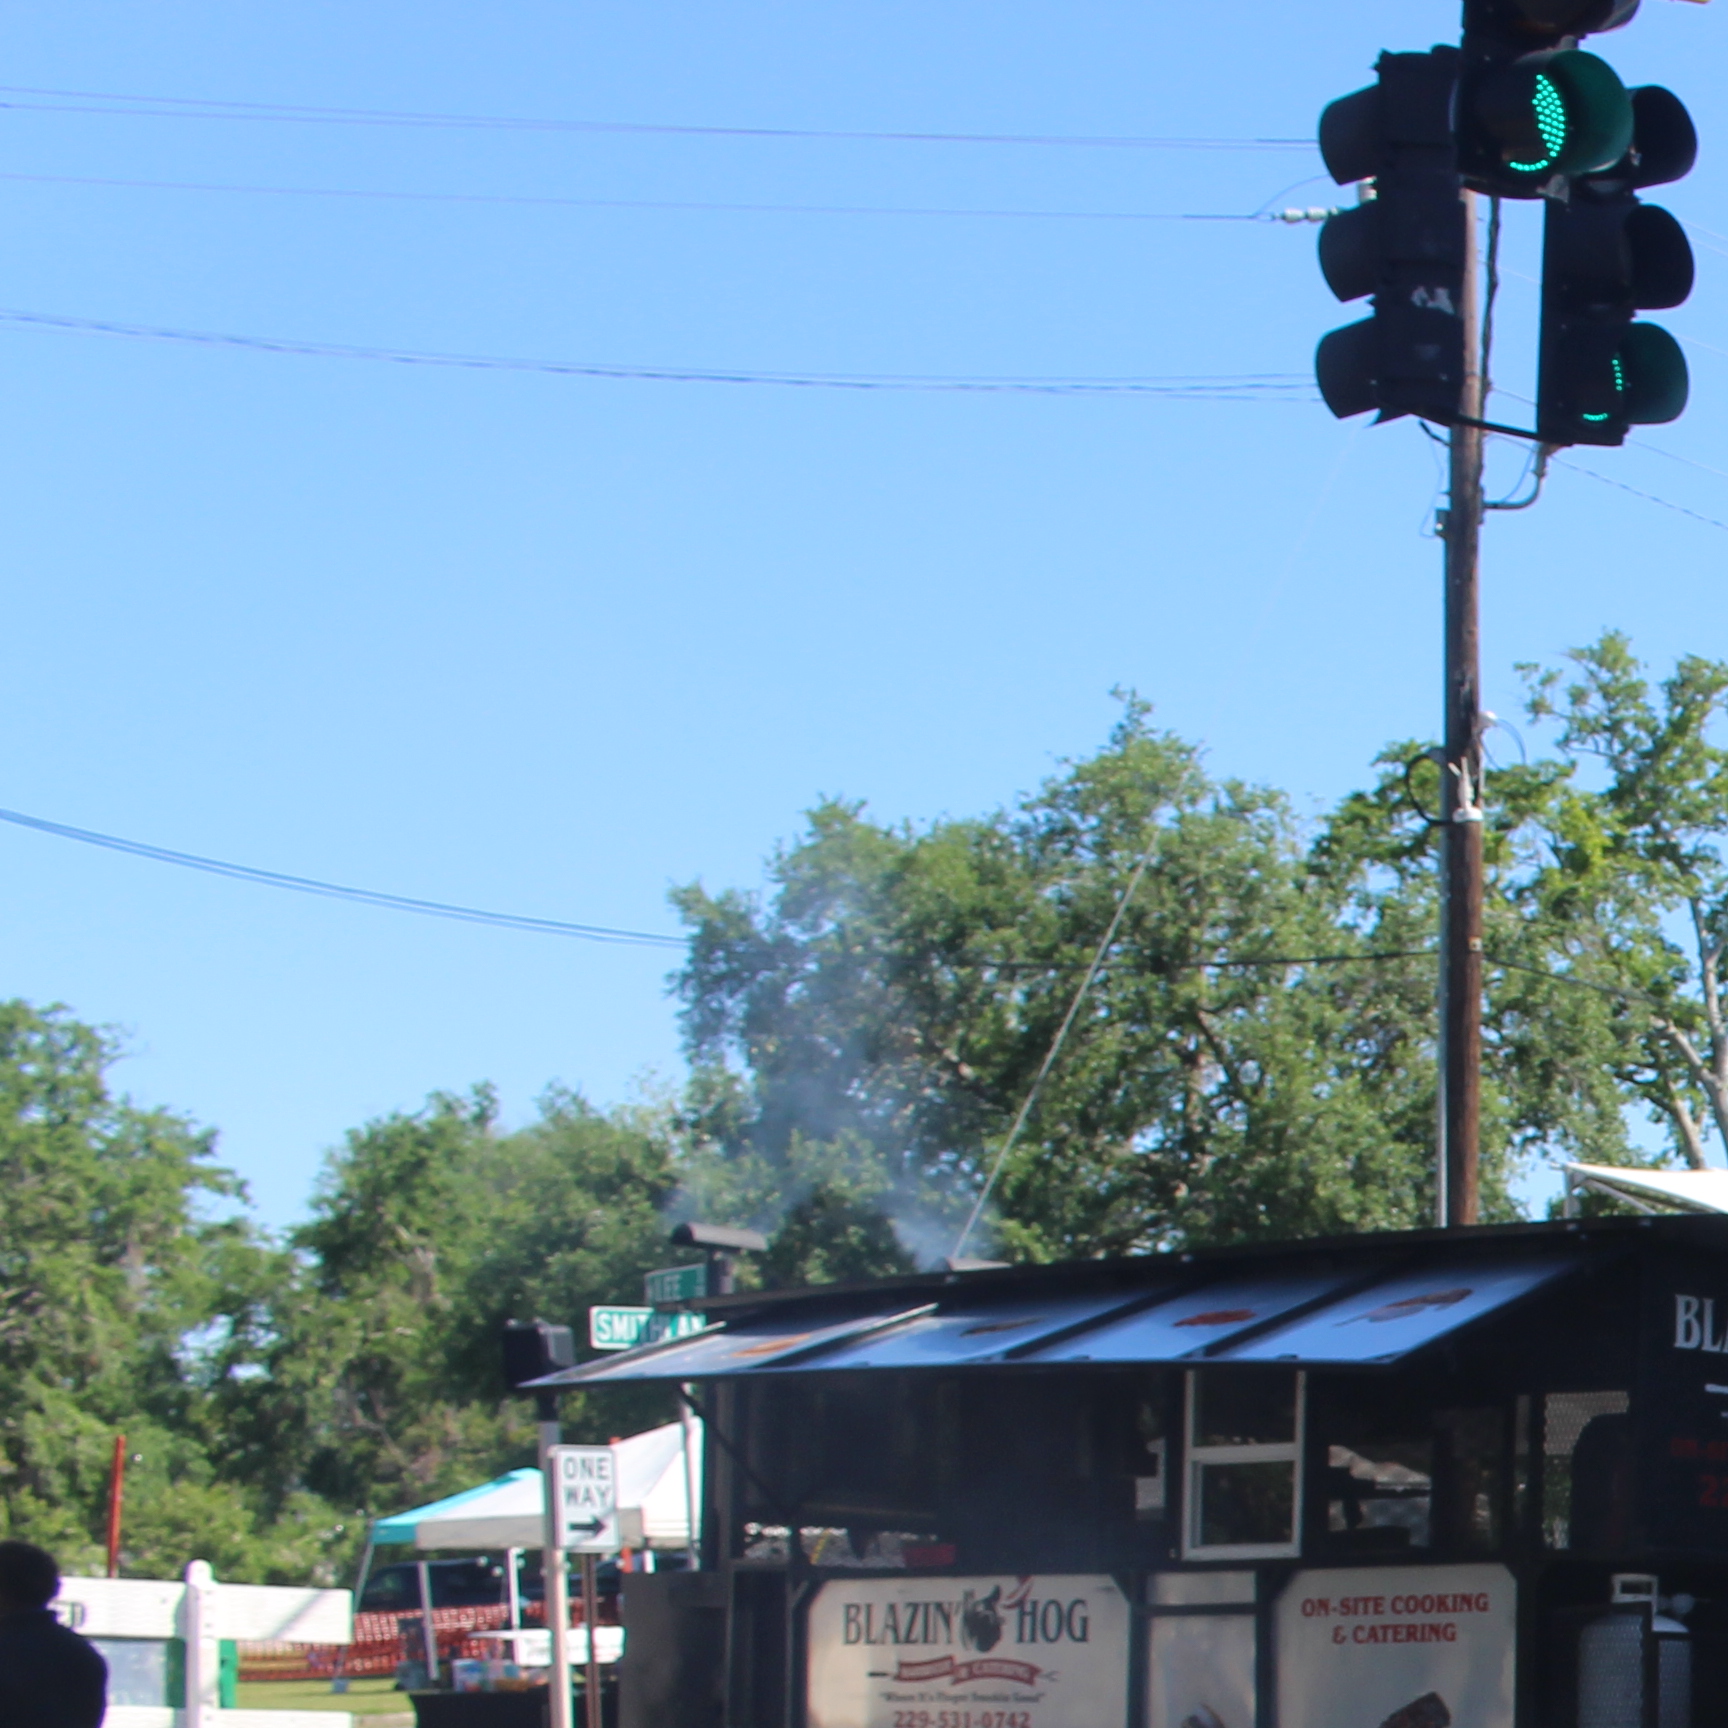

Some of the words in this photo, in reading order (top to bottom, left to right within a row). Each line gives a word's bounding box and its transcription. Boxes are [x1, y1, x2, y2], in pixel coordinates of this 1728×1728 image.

[563, 1456, 611, 1480] ONE
[563, 1485, 613, 1508] WAY
[1301, 1595, 1386, 1618] ON-SITE
[1390, 1592, 1490, 1615] COOKING
[1016, 1599, 1089, 1644] HOG
[1332, 1625, 1347, 1645] &
[1352, 1622, 1457, 1644] CATERING
